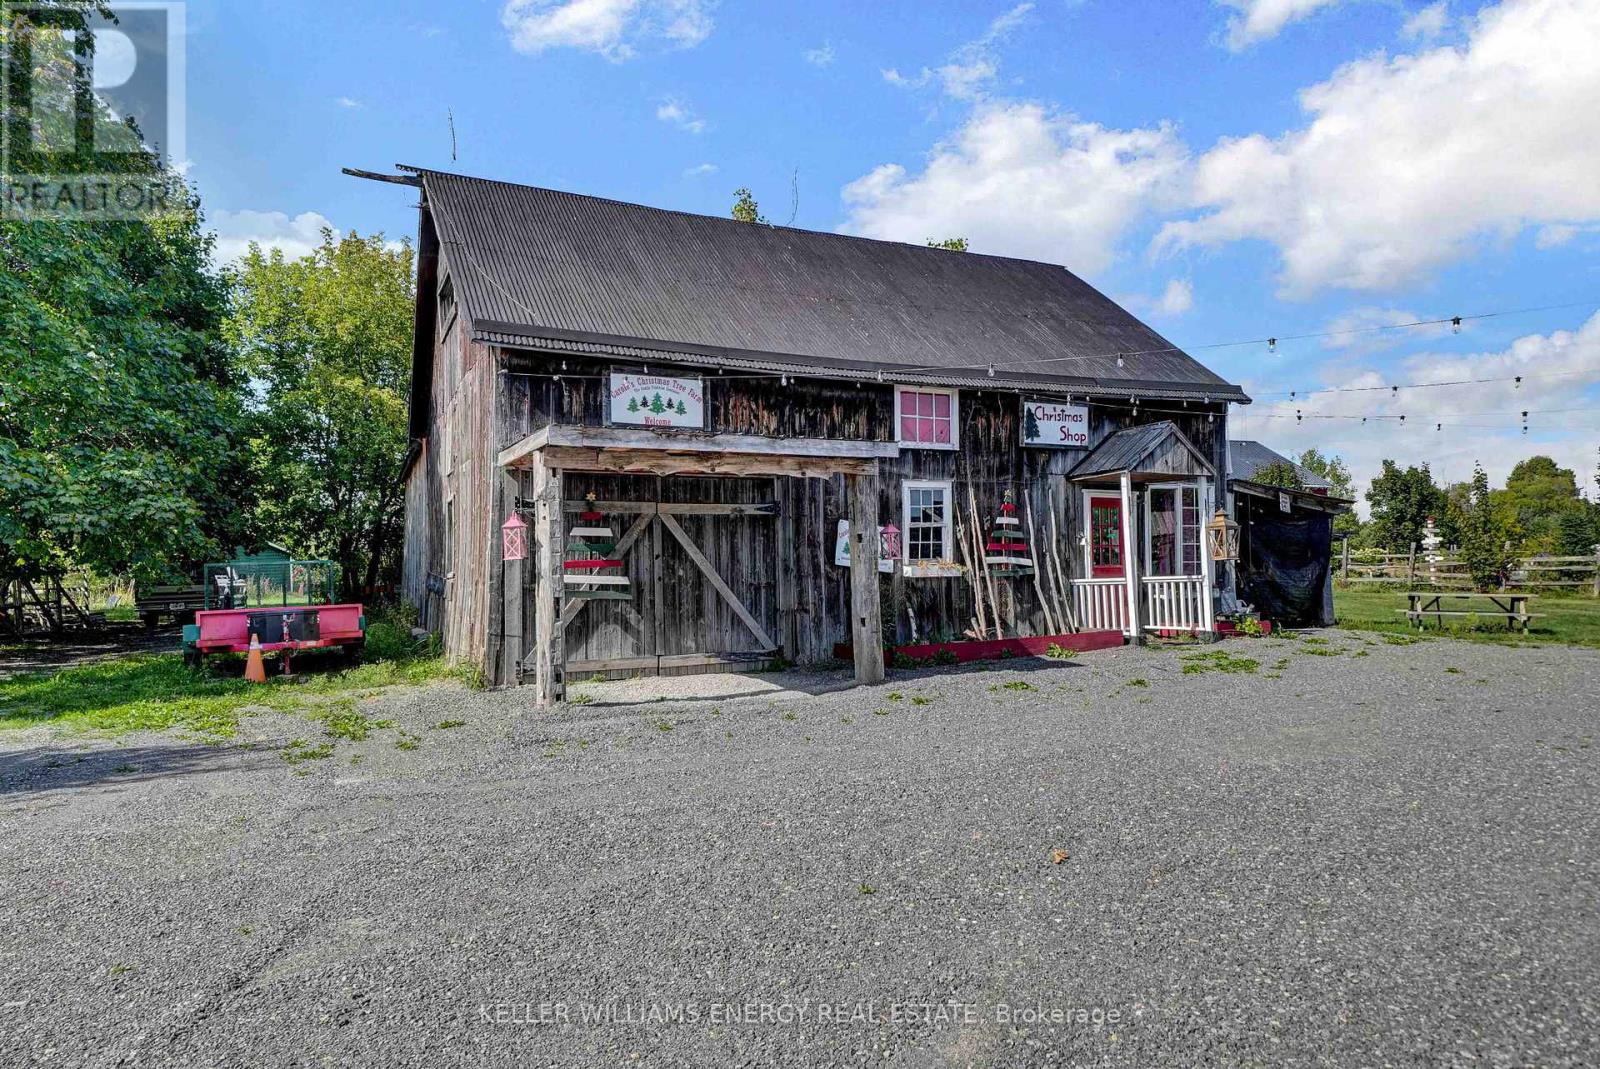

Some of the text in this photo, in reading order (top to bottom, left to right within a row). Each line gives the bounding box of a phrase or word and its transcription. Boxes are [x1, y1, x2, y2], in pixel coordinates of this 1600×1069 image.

[637, 377, 670, 386] Christmas
[673, 379, 687, 392] Tree
[688, 388, 702, 404] Farm
[645, 416, 672, 426] Welcome
[1034, 405, 1083, 422] Christmas
[1060, 425, 1087, 444] Shop
